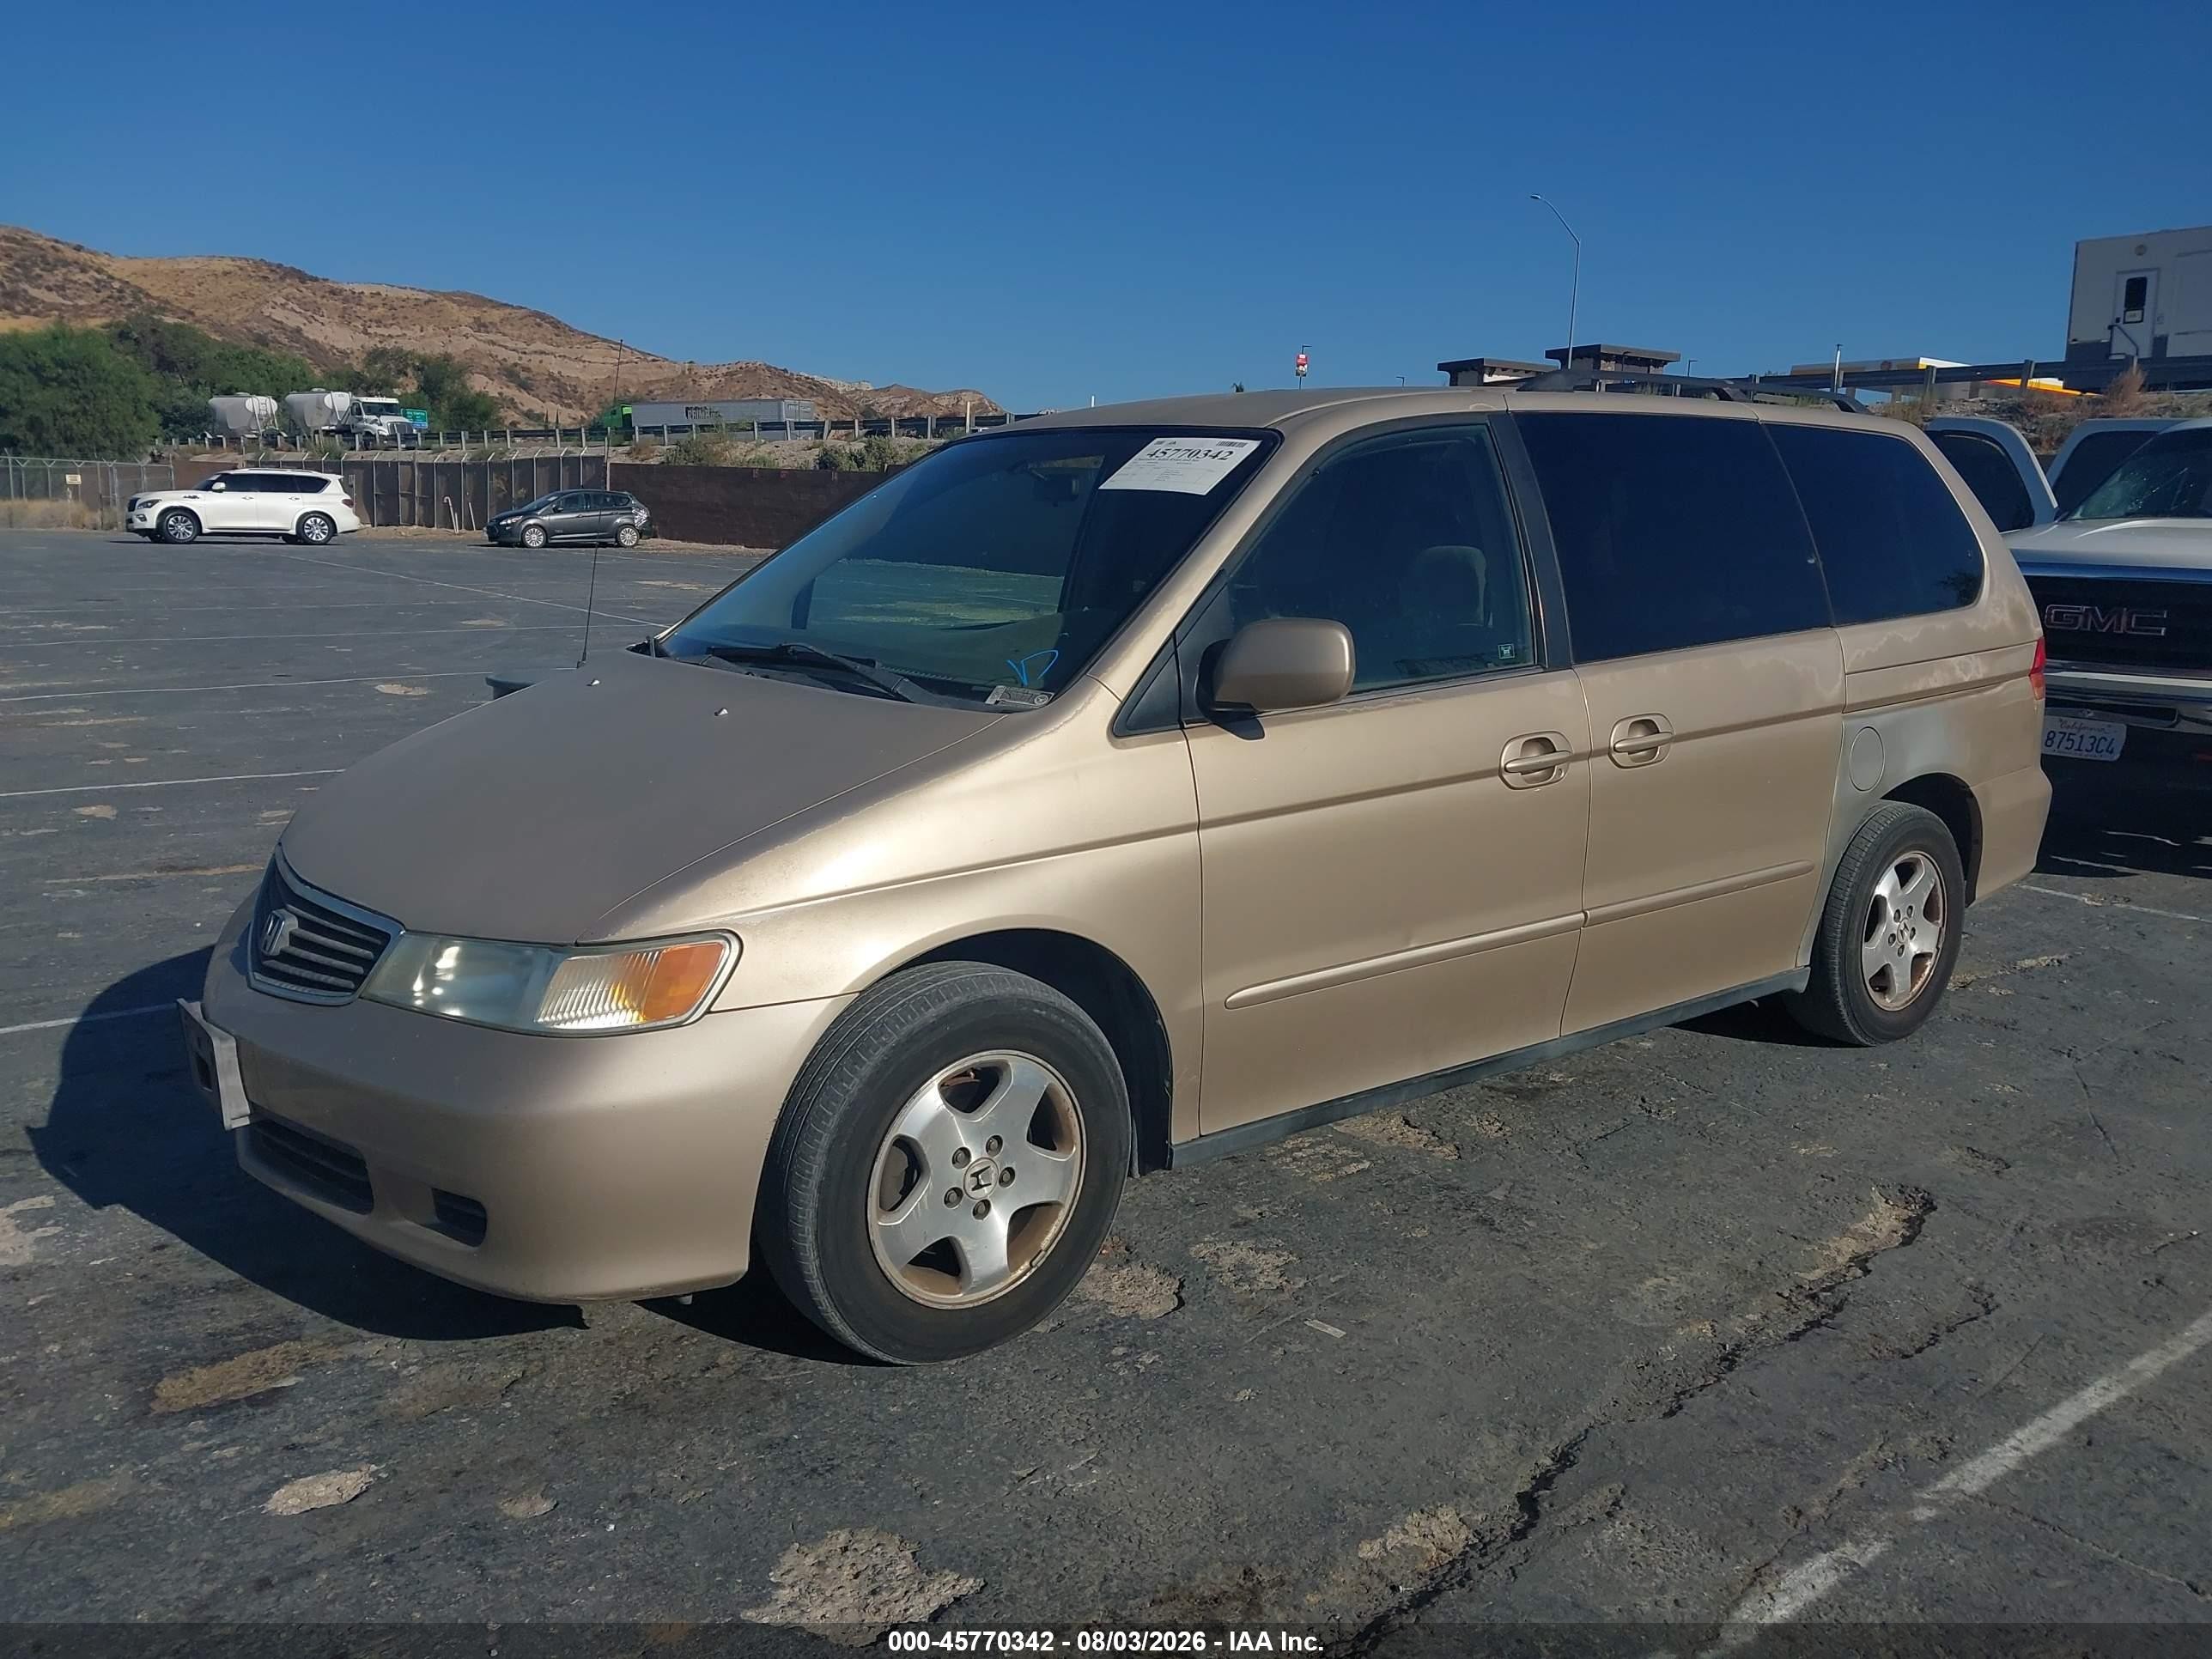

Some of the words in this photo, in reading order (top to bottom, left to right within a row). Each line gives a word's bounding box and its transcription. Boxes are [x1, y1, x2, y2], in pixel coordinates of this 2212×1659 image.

[1146, 448, 1234, 461] 45770342
[2045, 604, 2168, 636] GMC
[2045, 730, 2116, 755] 87513C4
